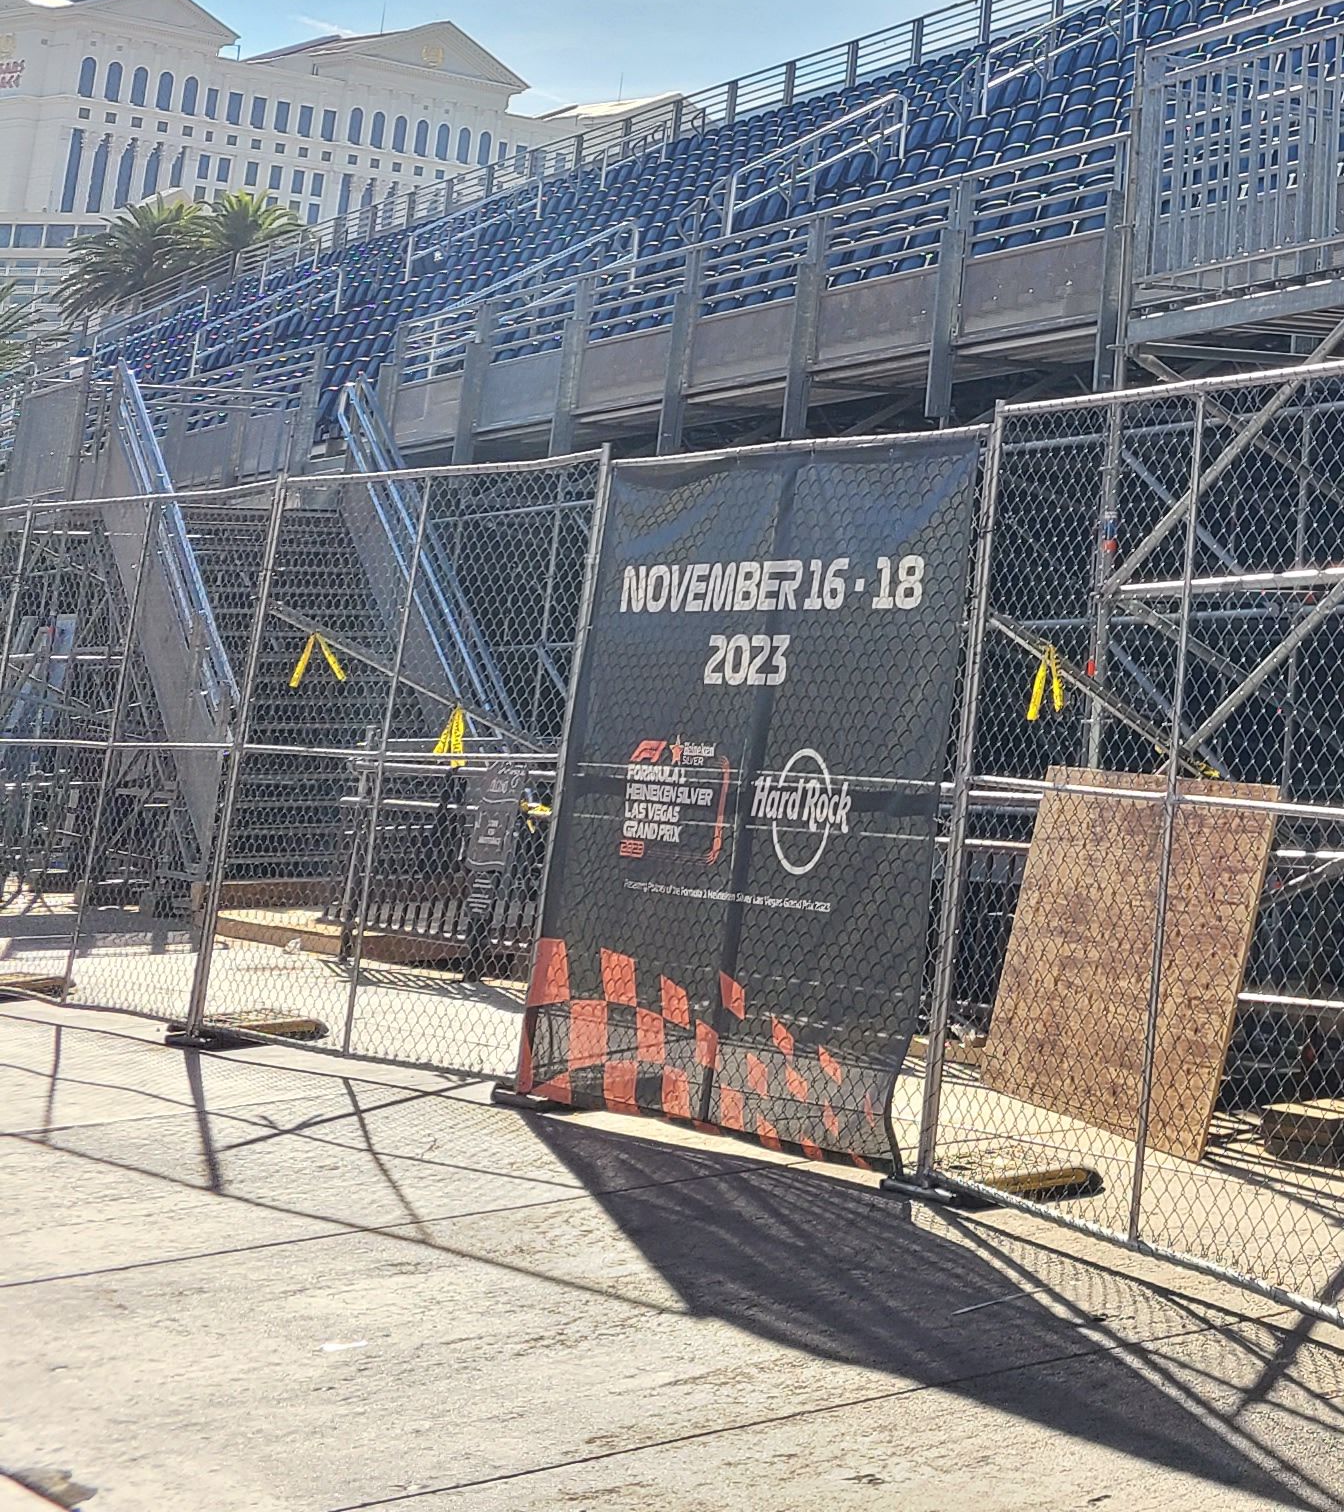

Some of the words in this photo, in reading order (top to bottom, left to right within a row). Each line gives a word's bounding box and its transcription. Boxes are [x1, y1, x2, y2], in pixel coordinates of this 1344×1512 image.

[619, 560, 803, 613] NOVEMBER
[803, 557, 850, 610] 16
[872, 555, 925, 609] 18
[703, 634, 791, 686] 2023
[627, 764, 679, 783] FORMULA
[679, 767, 687, 784] 1
[625, 783, 677, 803] HEINEKEN
[676, 787, 714, 806] SILVER
[750, 776, 805, 820] Hard
[801, 779, 852, 834] Rock
[625, 801, 647, 819] LAS
[647, 803, 681, 823] VEGAS
[622, 820, 658, 839] GRAND
[657, 824, 682, 843] PRIX
